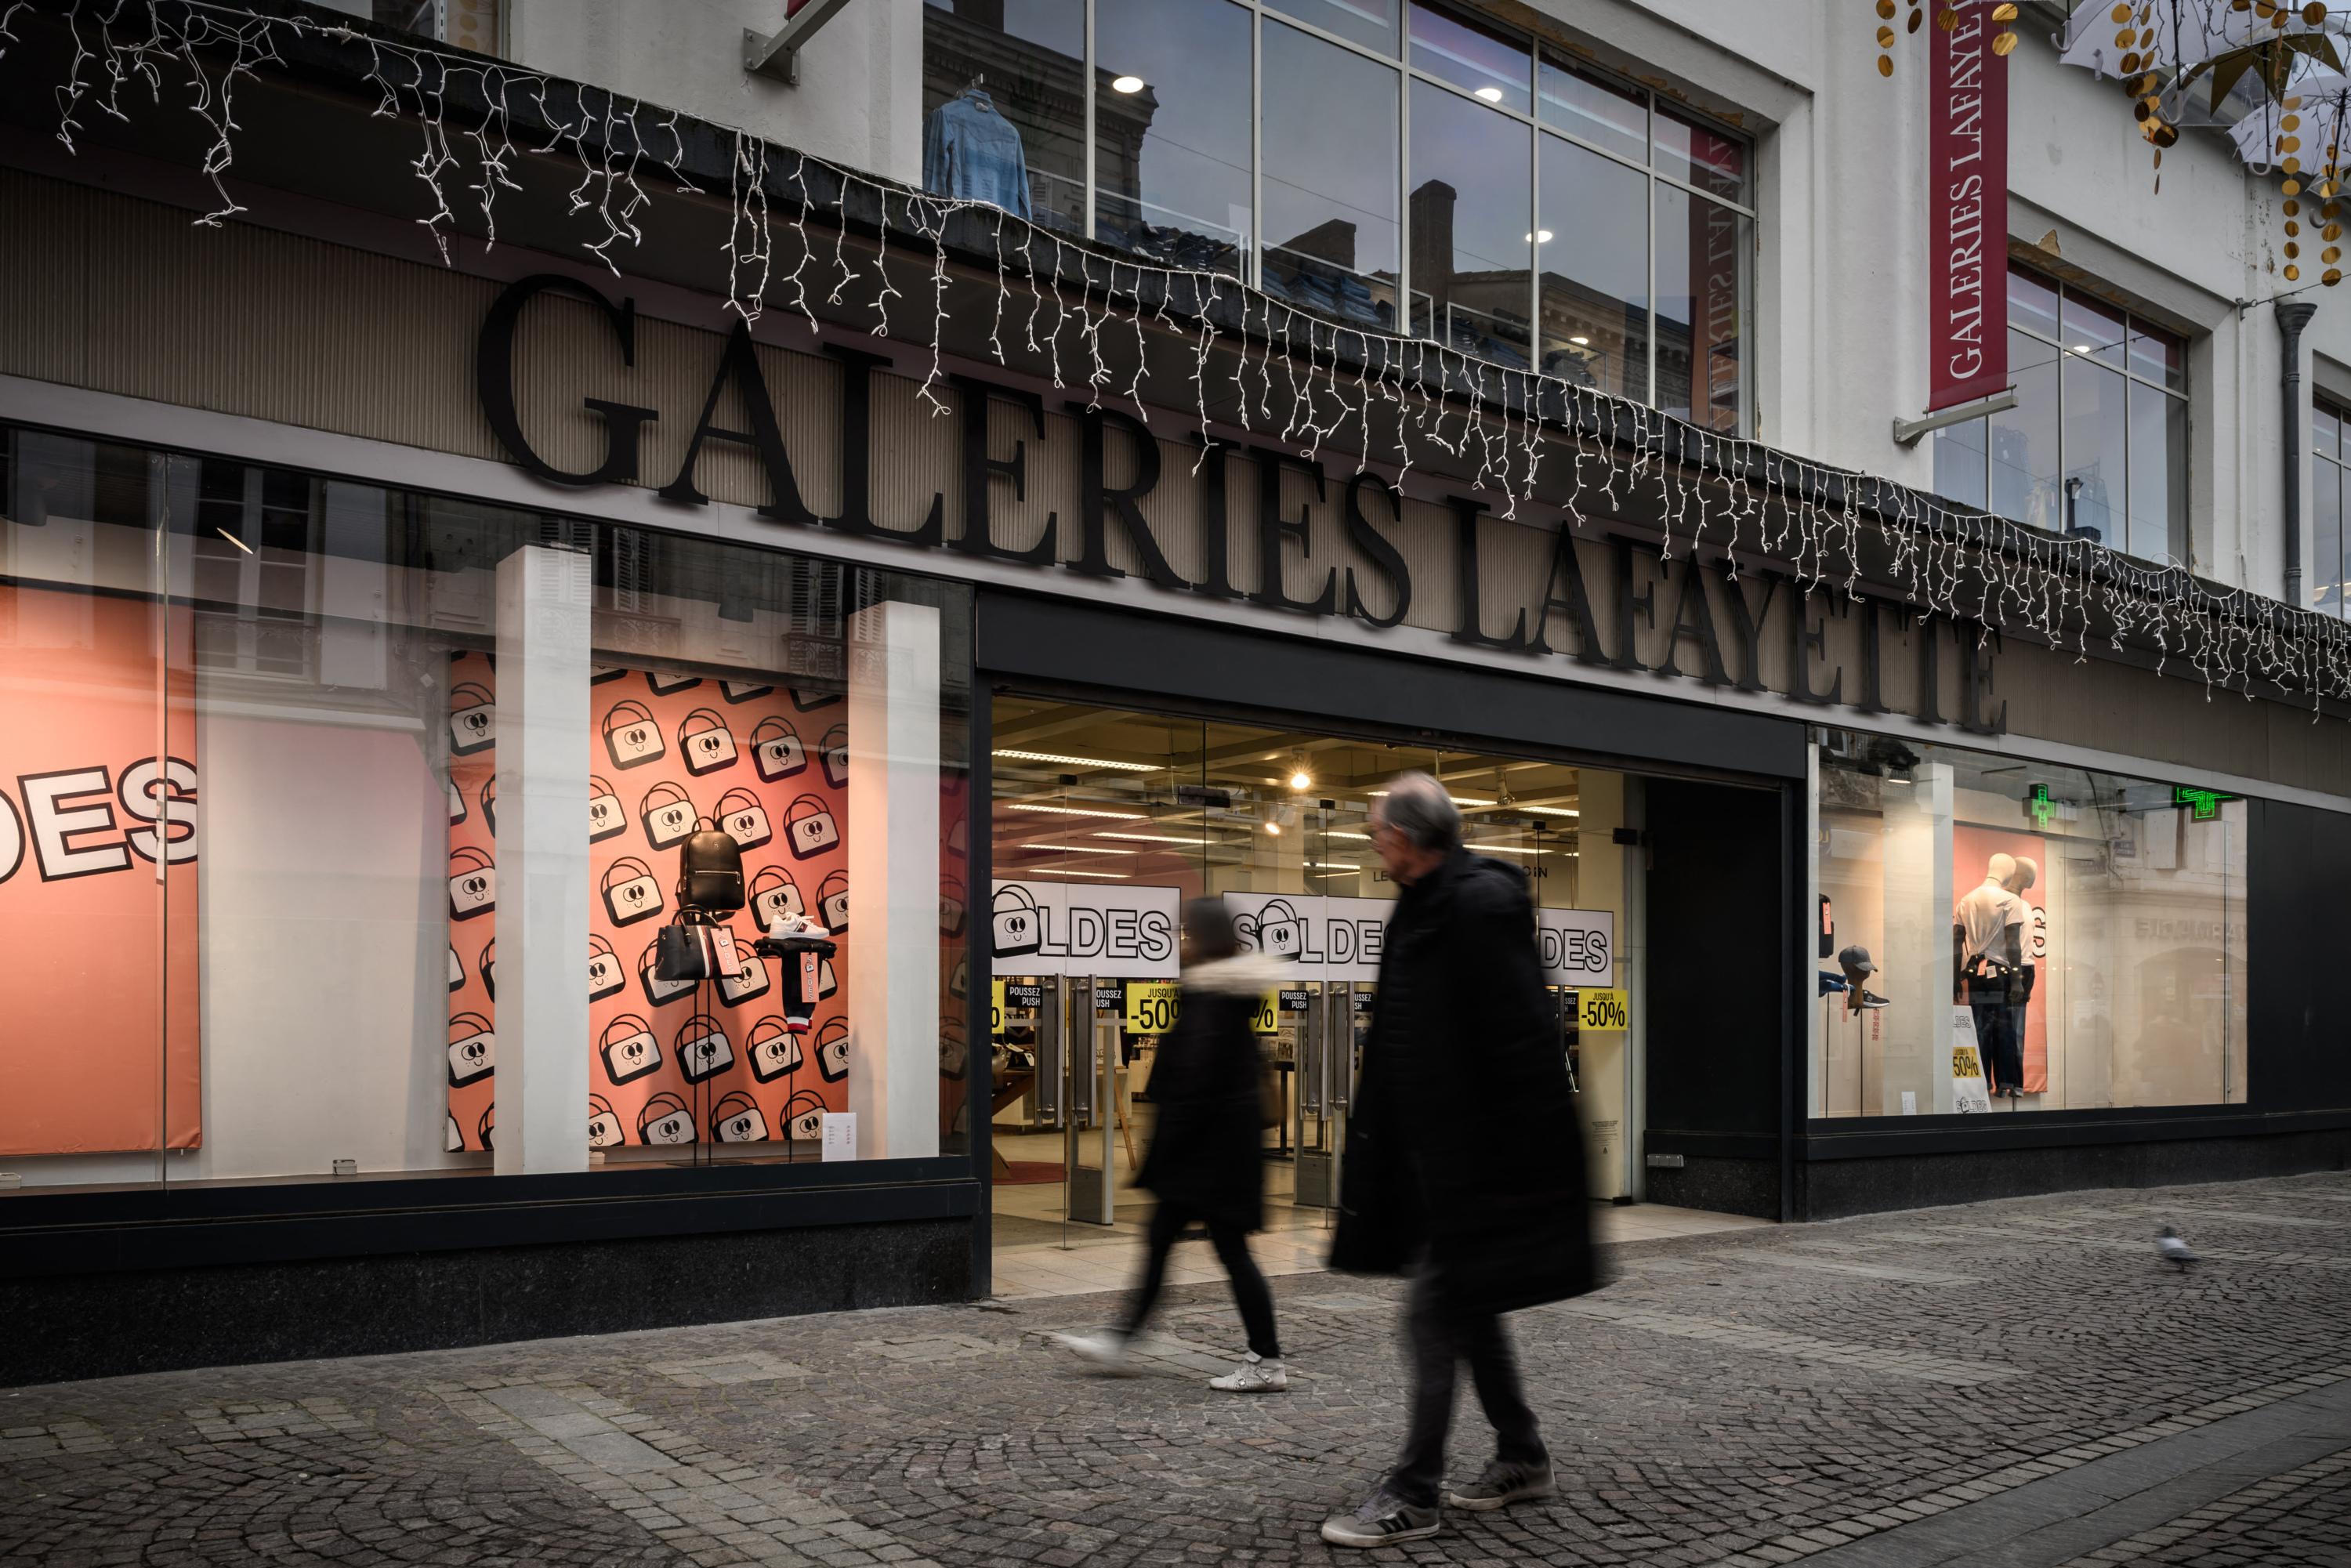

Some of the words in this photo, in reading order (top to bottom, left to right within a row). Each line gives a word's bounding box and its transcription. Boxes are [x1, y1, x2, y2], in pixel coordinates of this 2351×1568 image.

[1950, 173, 1982, 380] GALERIES
[476, 273, 1411, 628] GALERIES
[1446, 495, 2007, 736] LAFAYETTE
[0, 756, 197, 884] ES
[1232, 899, 1392, 965] SOLDE
[1009, 986, 1041, 997] POUSSEZ
[1022, 997, 1041, 1006] PUSH
[1281, 991, 1307, 1000] POUSSEZ
[1291, 1001, 1307, 1009] PUSH
[1581, 1001, 1625, 1027] -50%
